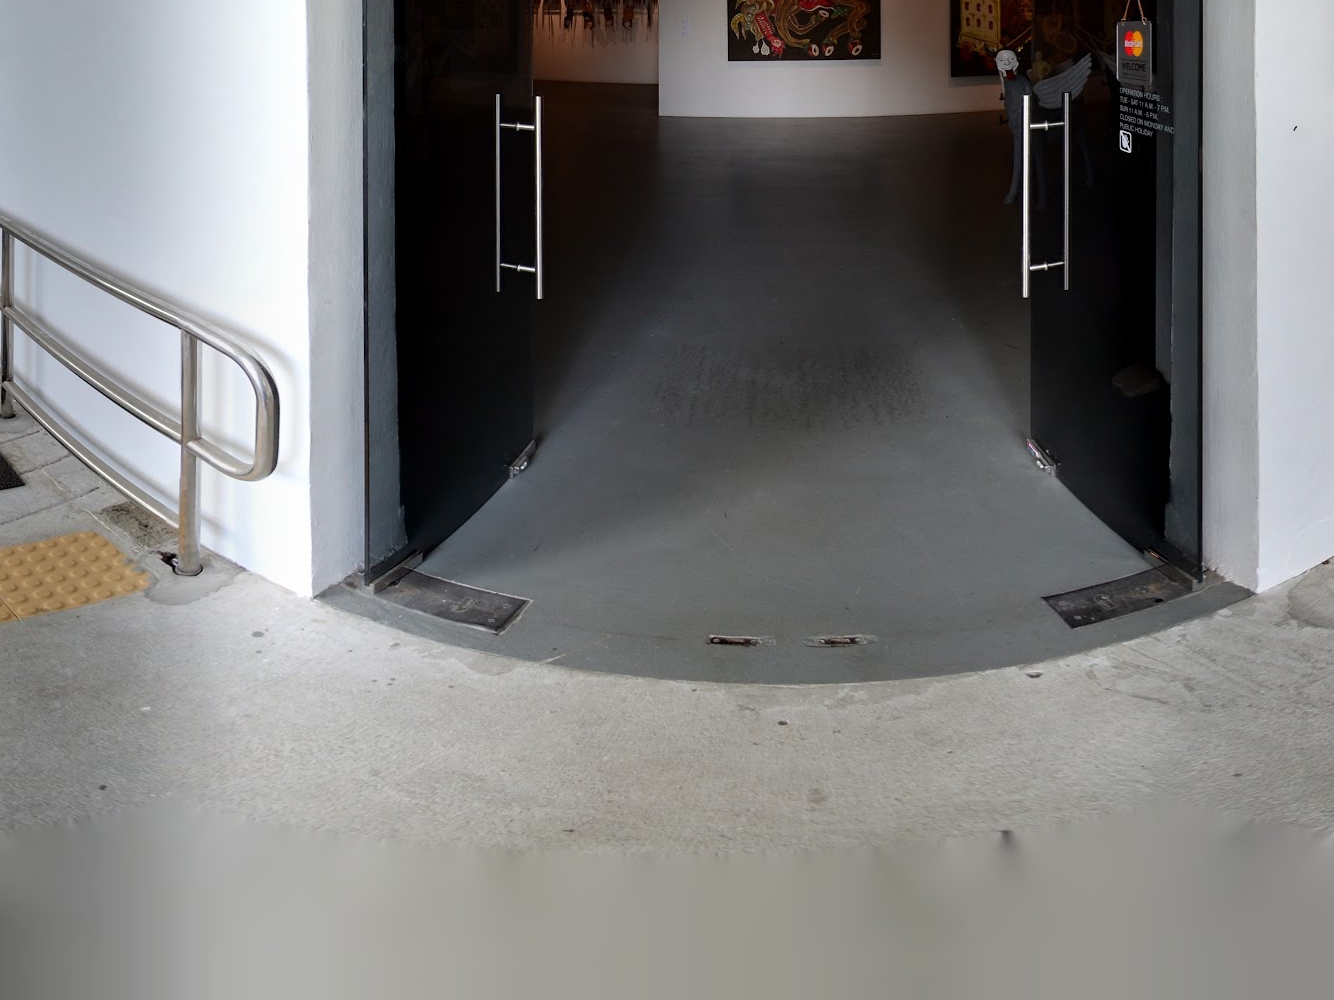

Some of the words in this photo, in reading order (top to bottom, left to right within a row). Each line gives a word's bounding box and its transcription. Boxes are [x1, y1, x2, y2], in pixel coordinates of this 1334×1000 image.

[1122, 62, 1146, 72] WELCOME
[1120, 87, 1143, 98] OPERATION
[1130, 98, 1139, 106] SAT
[1119, 104, 1129, 112] SUN
[1120, 113, 1136, 123] CLOSED
[1136, 118, 1144, 126] ON
[1144, 120, 1164, 130] MONDAY
[1163, 125, 1175, 134] AND
[1120, 122, 1134, 131] PUBLIC
[1135, 127, 1154, 137] HOLIDAY
